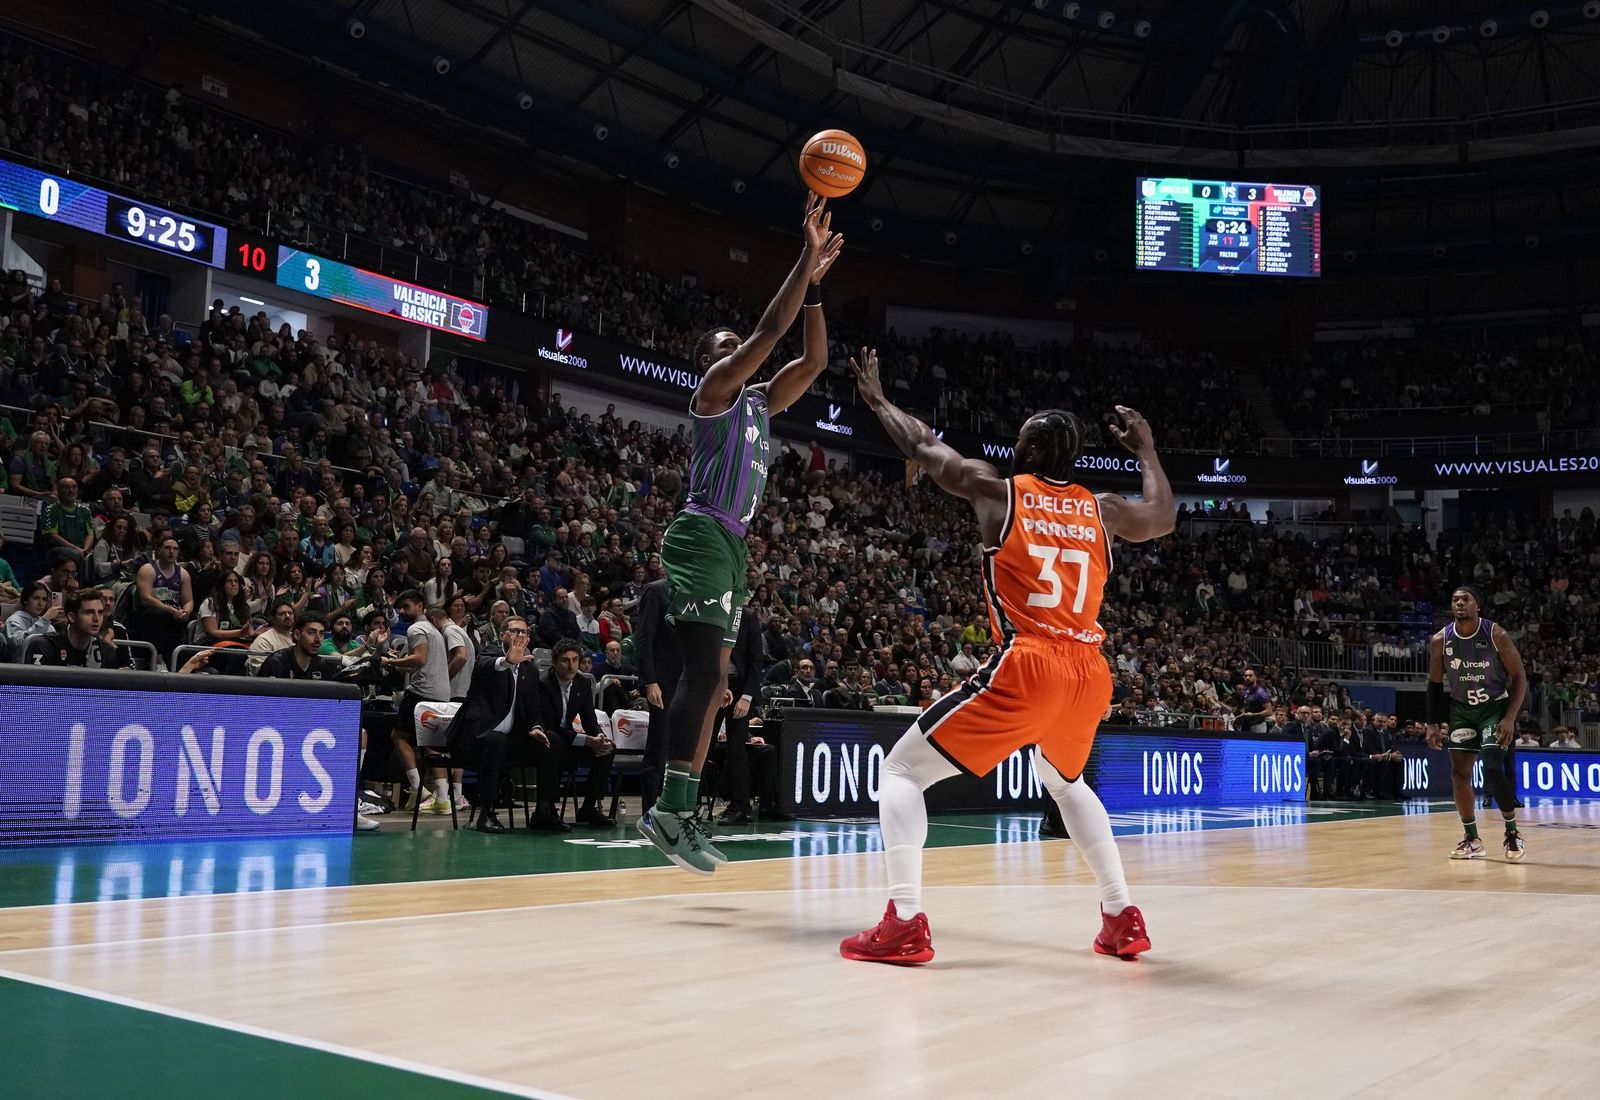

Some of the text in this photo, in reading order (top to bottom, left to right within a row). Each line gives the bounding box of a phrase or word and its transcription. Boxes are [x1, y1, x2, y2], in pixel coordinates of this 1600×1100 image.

[822, 143, 862, 165] Wilson
[40, 178, 60, 215] 0
[1202, 186, 1211, 198] 0
[1221, 186, 1236, 199] VS
[1248, 188, 1257, 200] 3
[1273, 189, 1300, 197] VALENCIA
[126, 206, 196, 253] 9:25
[1216, 220, 1247, 234] 9:24
[238, 243, 266, 272] 10
[304, 258, 321, 291] 3
[393, 283, 447, 313] VALENCIA
[401, 302, 447, 328] BASKET
[537, 347, 587, 370] visuales2000
[619, 353, 703, 390] WWW.VISU
[815, 418, 853, 436] visuales2000
[982, 443, 1015, 459] WW
[1197, 473, 1247, 484] visuales2000
[1344, 475, 1397, 486] visuales2000
[1022, 492, 1094, 518] OJELEYE
[1023, 517, 1097, 543] PAMESA
[1026, 543, 1090, 614] 37
[1467, 688, 1490, 706] 55
[62, 722, 336, 820] IONOS
[794, 741, 885, 804] IONO
[996, 748, 1043, 800] ION
[1143, 750, 1204, 796] IONOS
[1253, 753, 1301, 793] IONOS
[1522, 761, 1600, 792] IONO
